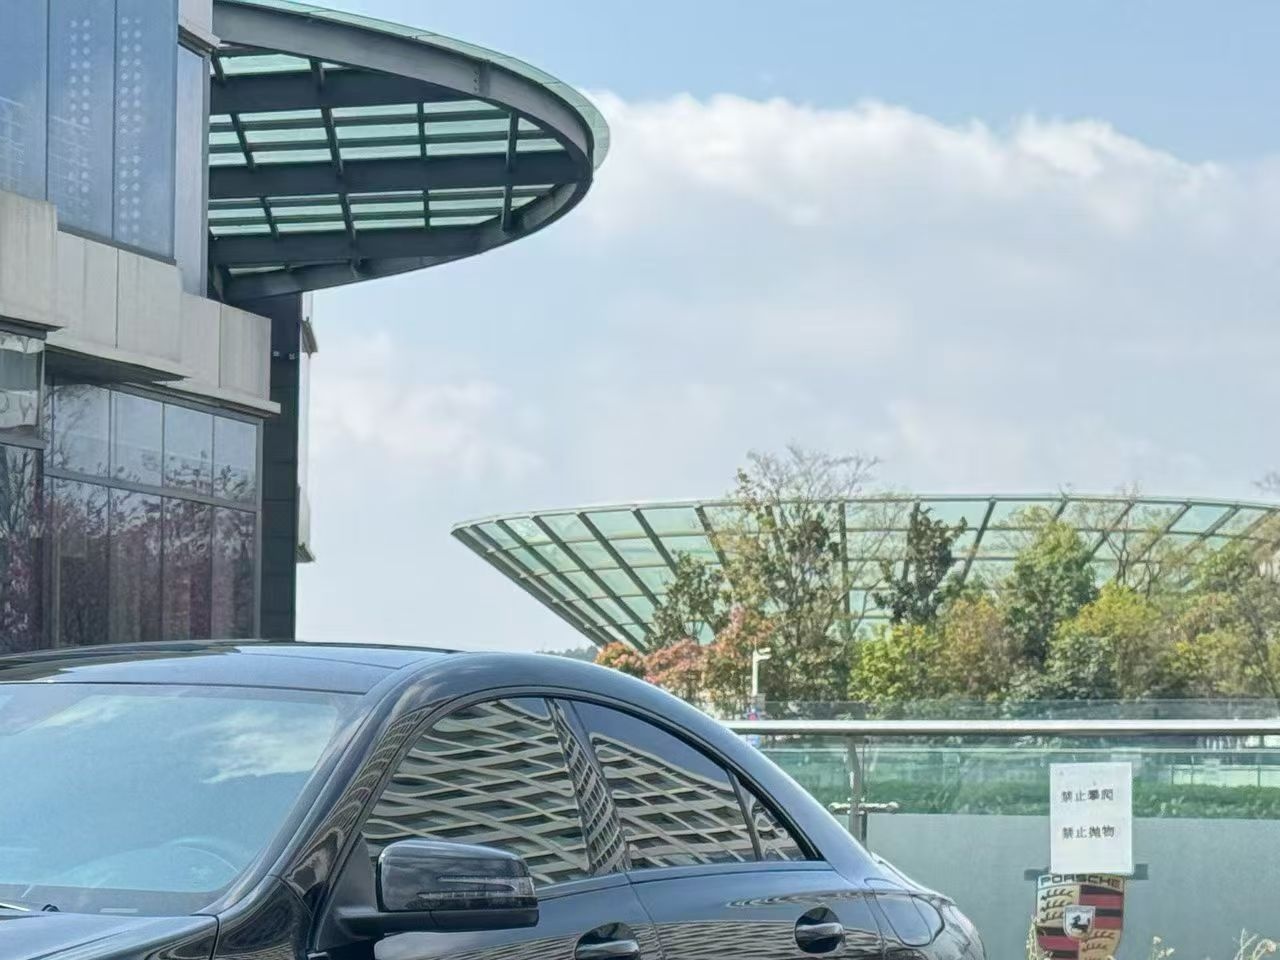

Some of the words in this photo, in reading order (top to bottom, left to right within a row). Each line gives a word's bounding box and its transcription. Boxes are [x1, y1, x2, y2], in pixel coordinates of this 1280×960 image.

[1062, 789, 1113, 802] 禁止攀爬
[1063, 826, 1114, 838] 禁止抛物
[1041, 874, 1120, 888] PORSCHE
